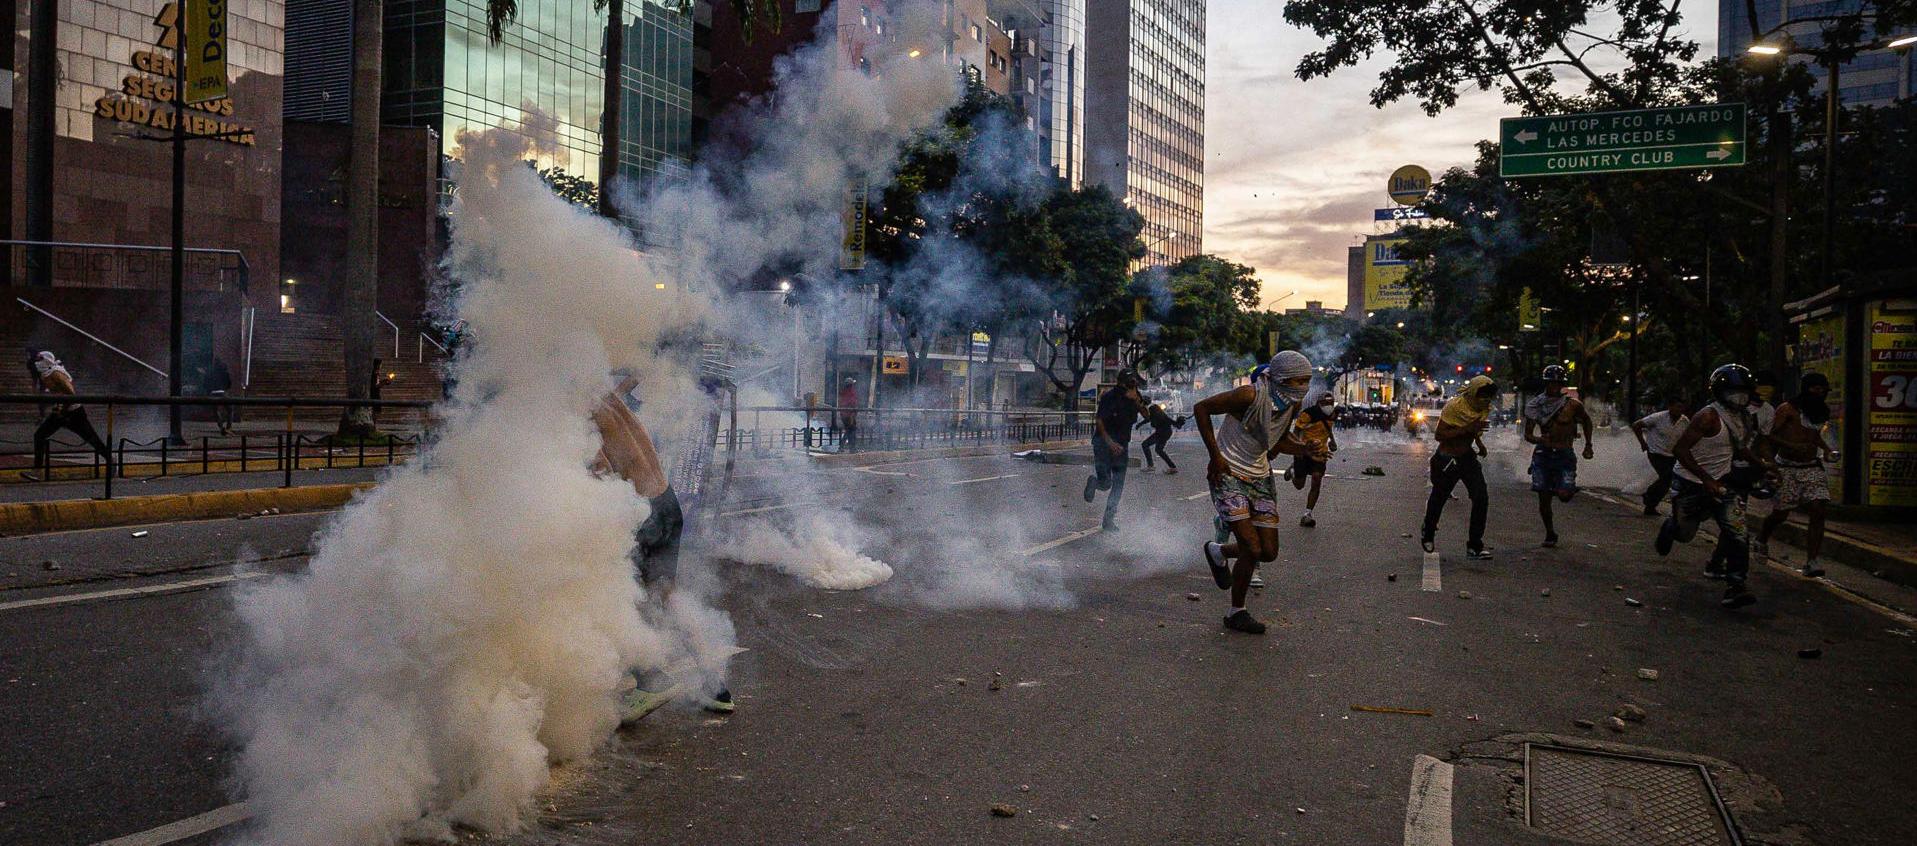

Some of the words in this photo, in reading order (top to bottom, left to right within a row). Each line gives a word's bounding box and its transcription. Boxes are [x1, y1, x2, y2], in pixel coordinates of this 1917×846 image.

[203, 0, 222, 63] Dec
[1549, 118, 1605, 133] AUTOP.
[1656, 109, 1734, 125] FAJARDO
[1547, 135, 1578, 149] LAS
[1586, 129, 1676, 146] MERCEDES
[1547, 154, 1623, 169] COUNTRY
[1632, 151, 1675, 165] CLUB
[1394, 176, 1426, 192] Daka
